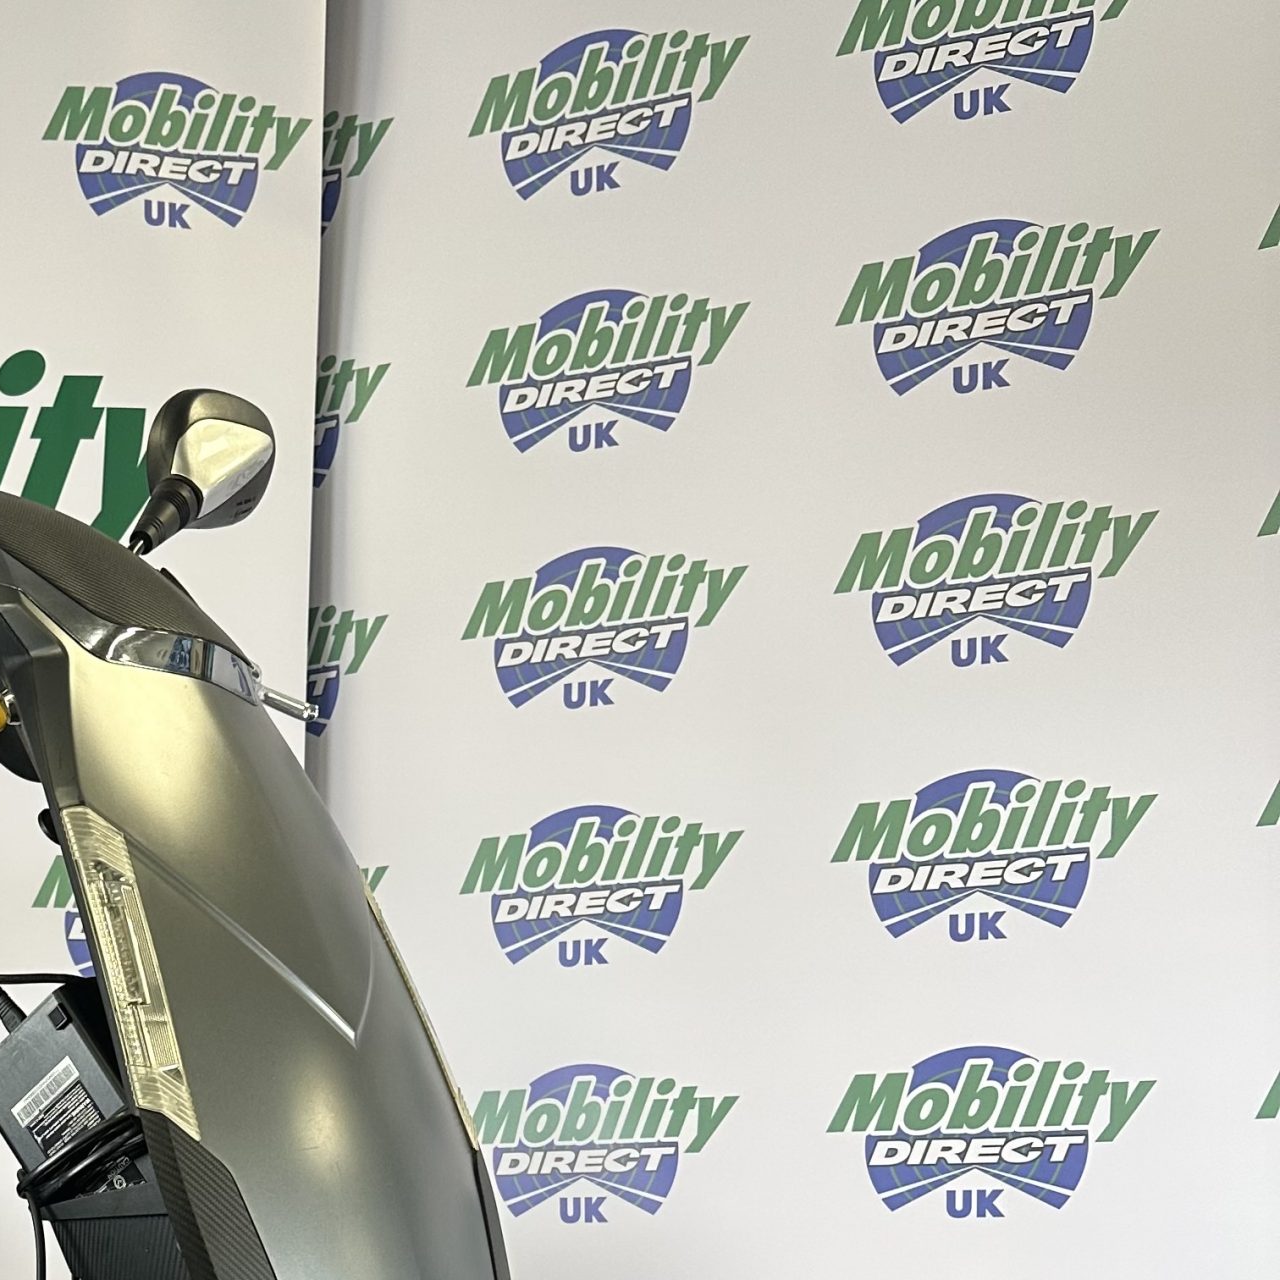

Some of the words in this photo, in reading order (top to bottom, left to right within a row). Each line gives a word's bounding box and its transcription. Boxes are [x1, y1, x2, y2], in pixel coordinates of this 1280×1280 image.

[879, 17, 1091, 82] DIRECT
[468, 30, 750, 137] Mobility
[953, 83, 1011, 120] UK
[42, 87, 313, 170] Mobility
[506, 100, 687, 161] DIRECT
[79, 150, 255, 185] DIRECT
[571, 162, 620, 196] UK
[144, 200, 191, 229] UK
[834, 222, 1160, 327] Mobility
[465, 294, 750, 386] Mobility
[879, 297, 1088, 354] DIRECT
[505, 364, 687, 413] DIRECT
[954, 359, 1010, 394] UK
[570, 420, 619, 452] UK
[832, 499, 1159, 595] Mobility
[461, 554, 749, 640] Mobility
[877, 576, 1087, 623] DIRECT
[499, 625, 684, 667] DIRECT
[952, 634, 1008, 667] UK
[564, 679, 614, 709] UK
[830, 779, 1158, 863] Mobility
[459, 815, 744, 895] Mobility
[875, 856, 1085, 894] DIRECT
[495, 887, 678, 922] DIRECT
[950, 911, 1007, 942] UK
[560, 938, 609, 967] UK
[473, 1077, 739, 1153] Mobility
[826, 1061, 1157, 1142] Mobility
[496, 1147, 675, 1175] DIRECT
[871, 1138, 1084, 1166] DIRECT
[560, 1197, 608, 1223] UK
[947, 1190, 1004, 1219] UK
